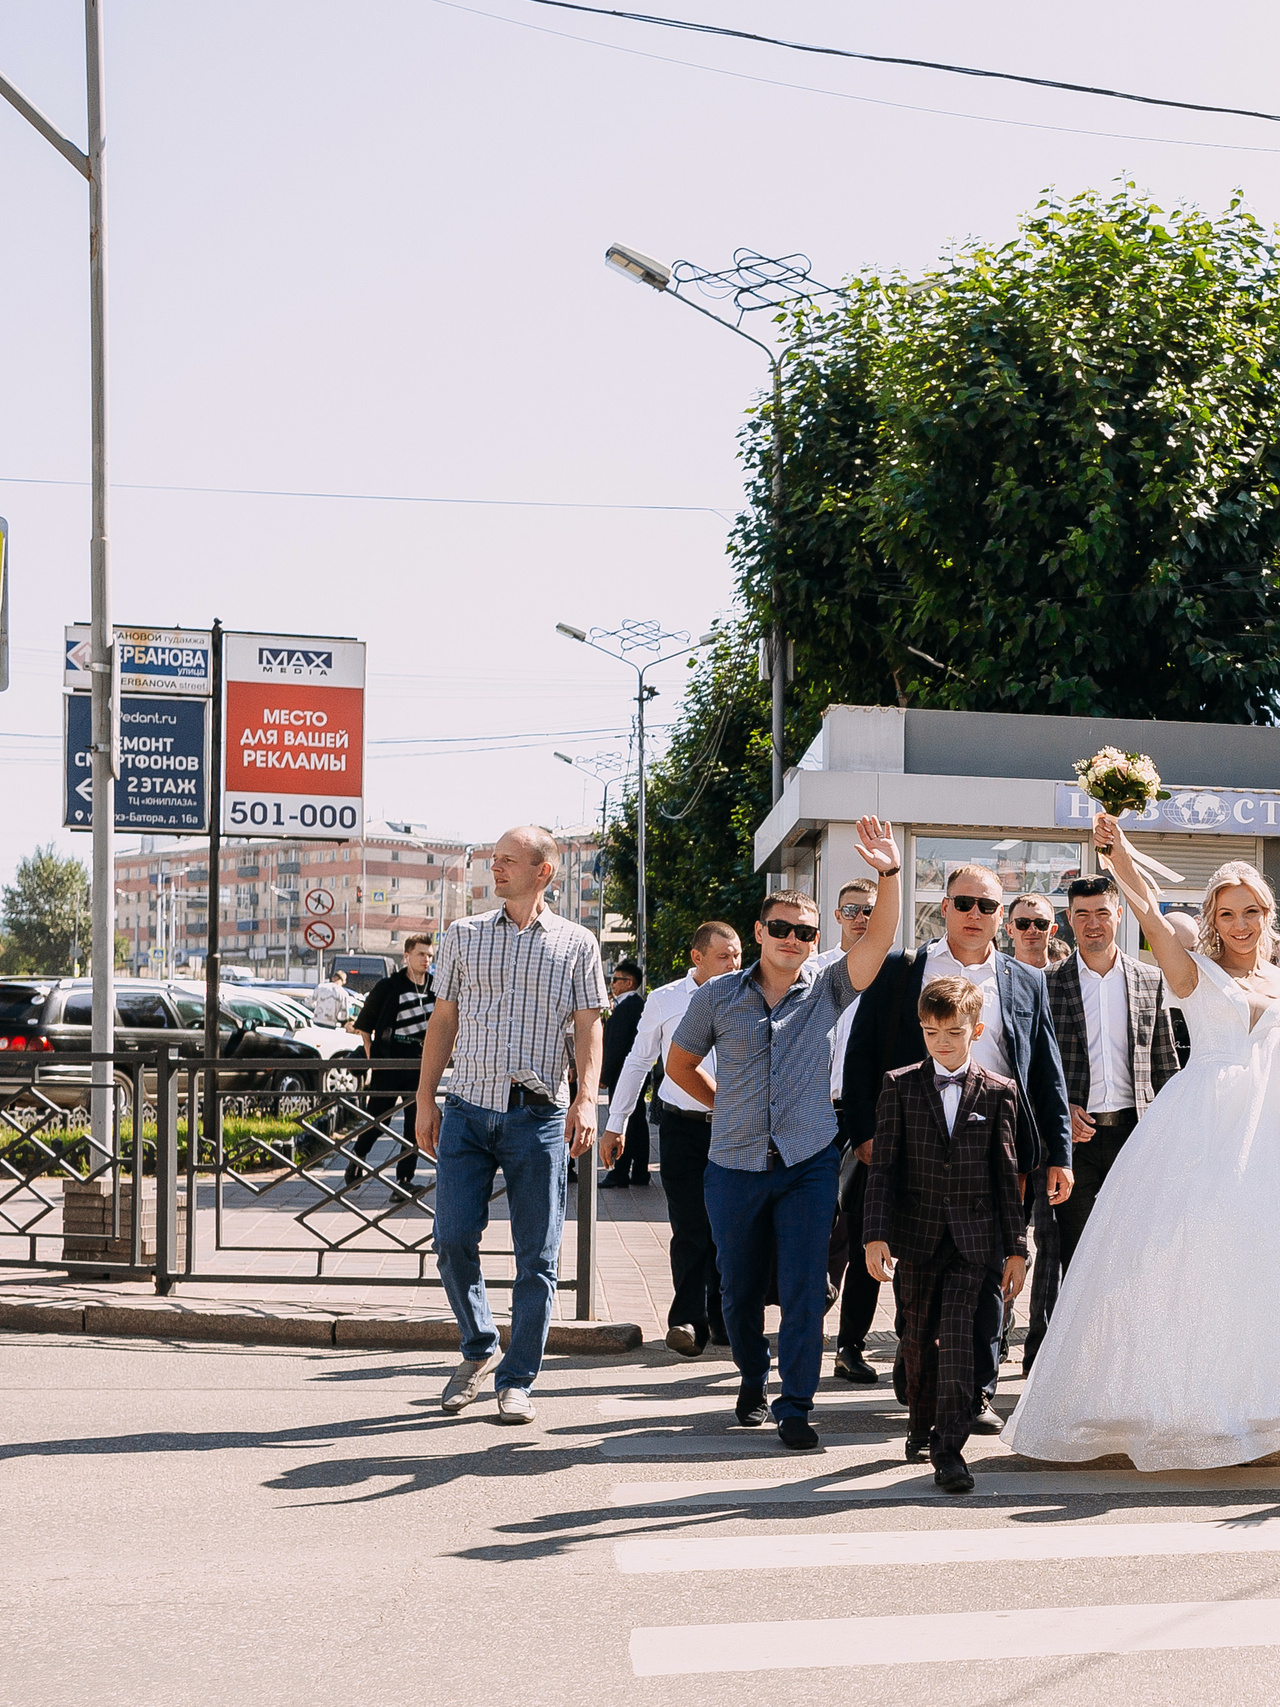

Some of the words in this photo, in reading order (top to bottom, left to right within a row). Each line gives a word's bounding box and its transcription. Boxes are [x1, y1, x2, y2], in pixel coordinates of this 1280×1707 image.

[116, 631, 162, 643] АНОВОЙ
[262, 649, 329, 669] MAX
[177, 667, 205, 677] улица
[262, 666, 328, 676] MEDIA
[263, 708, 328, 727] МЕСТО
[240, 728, 278, 746] ДЛЯ
[283, 729, 349, 749] ВАШЕЙ
[243, 749, 347, 772] РЕКЛАМЫ
[127, 776, 138, 793] 2
[140, 777, 197, 795] ЭТАЖ
[128, 796, 140, 807] ТЦ
[115, 812, 167, 824] хэ-Батора,
[181, 814, 199, 824] 16а
[230, 801, 357, 829] 501-000
